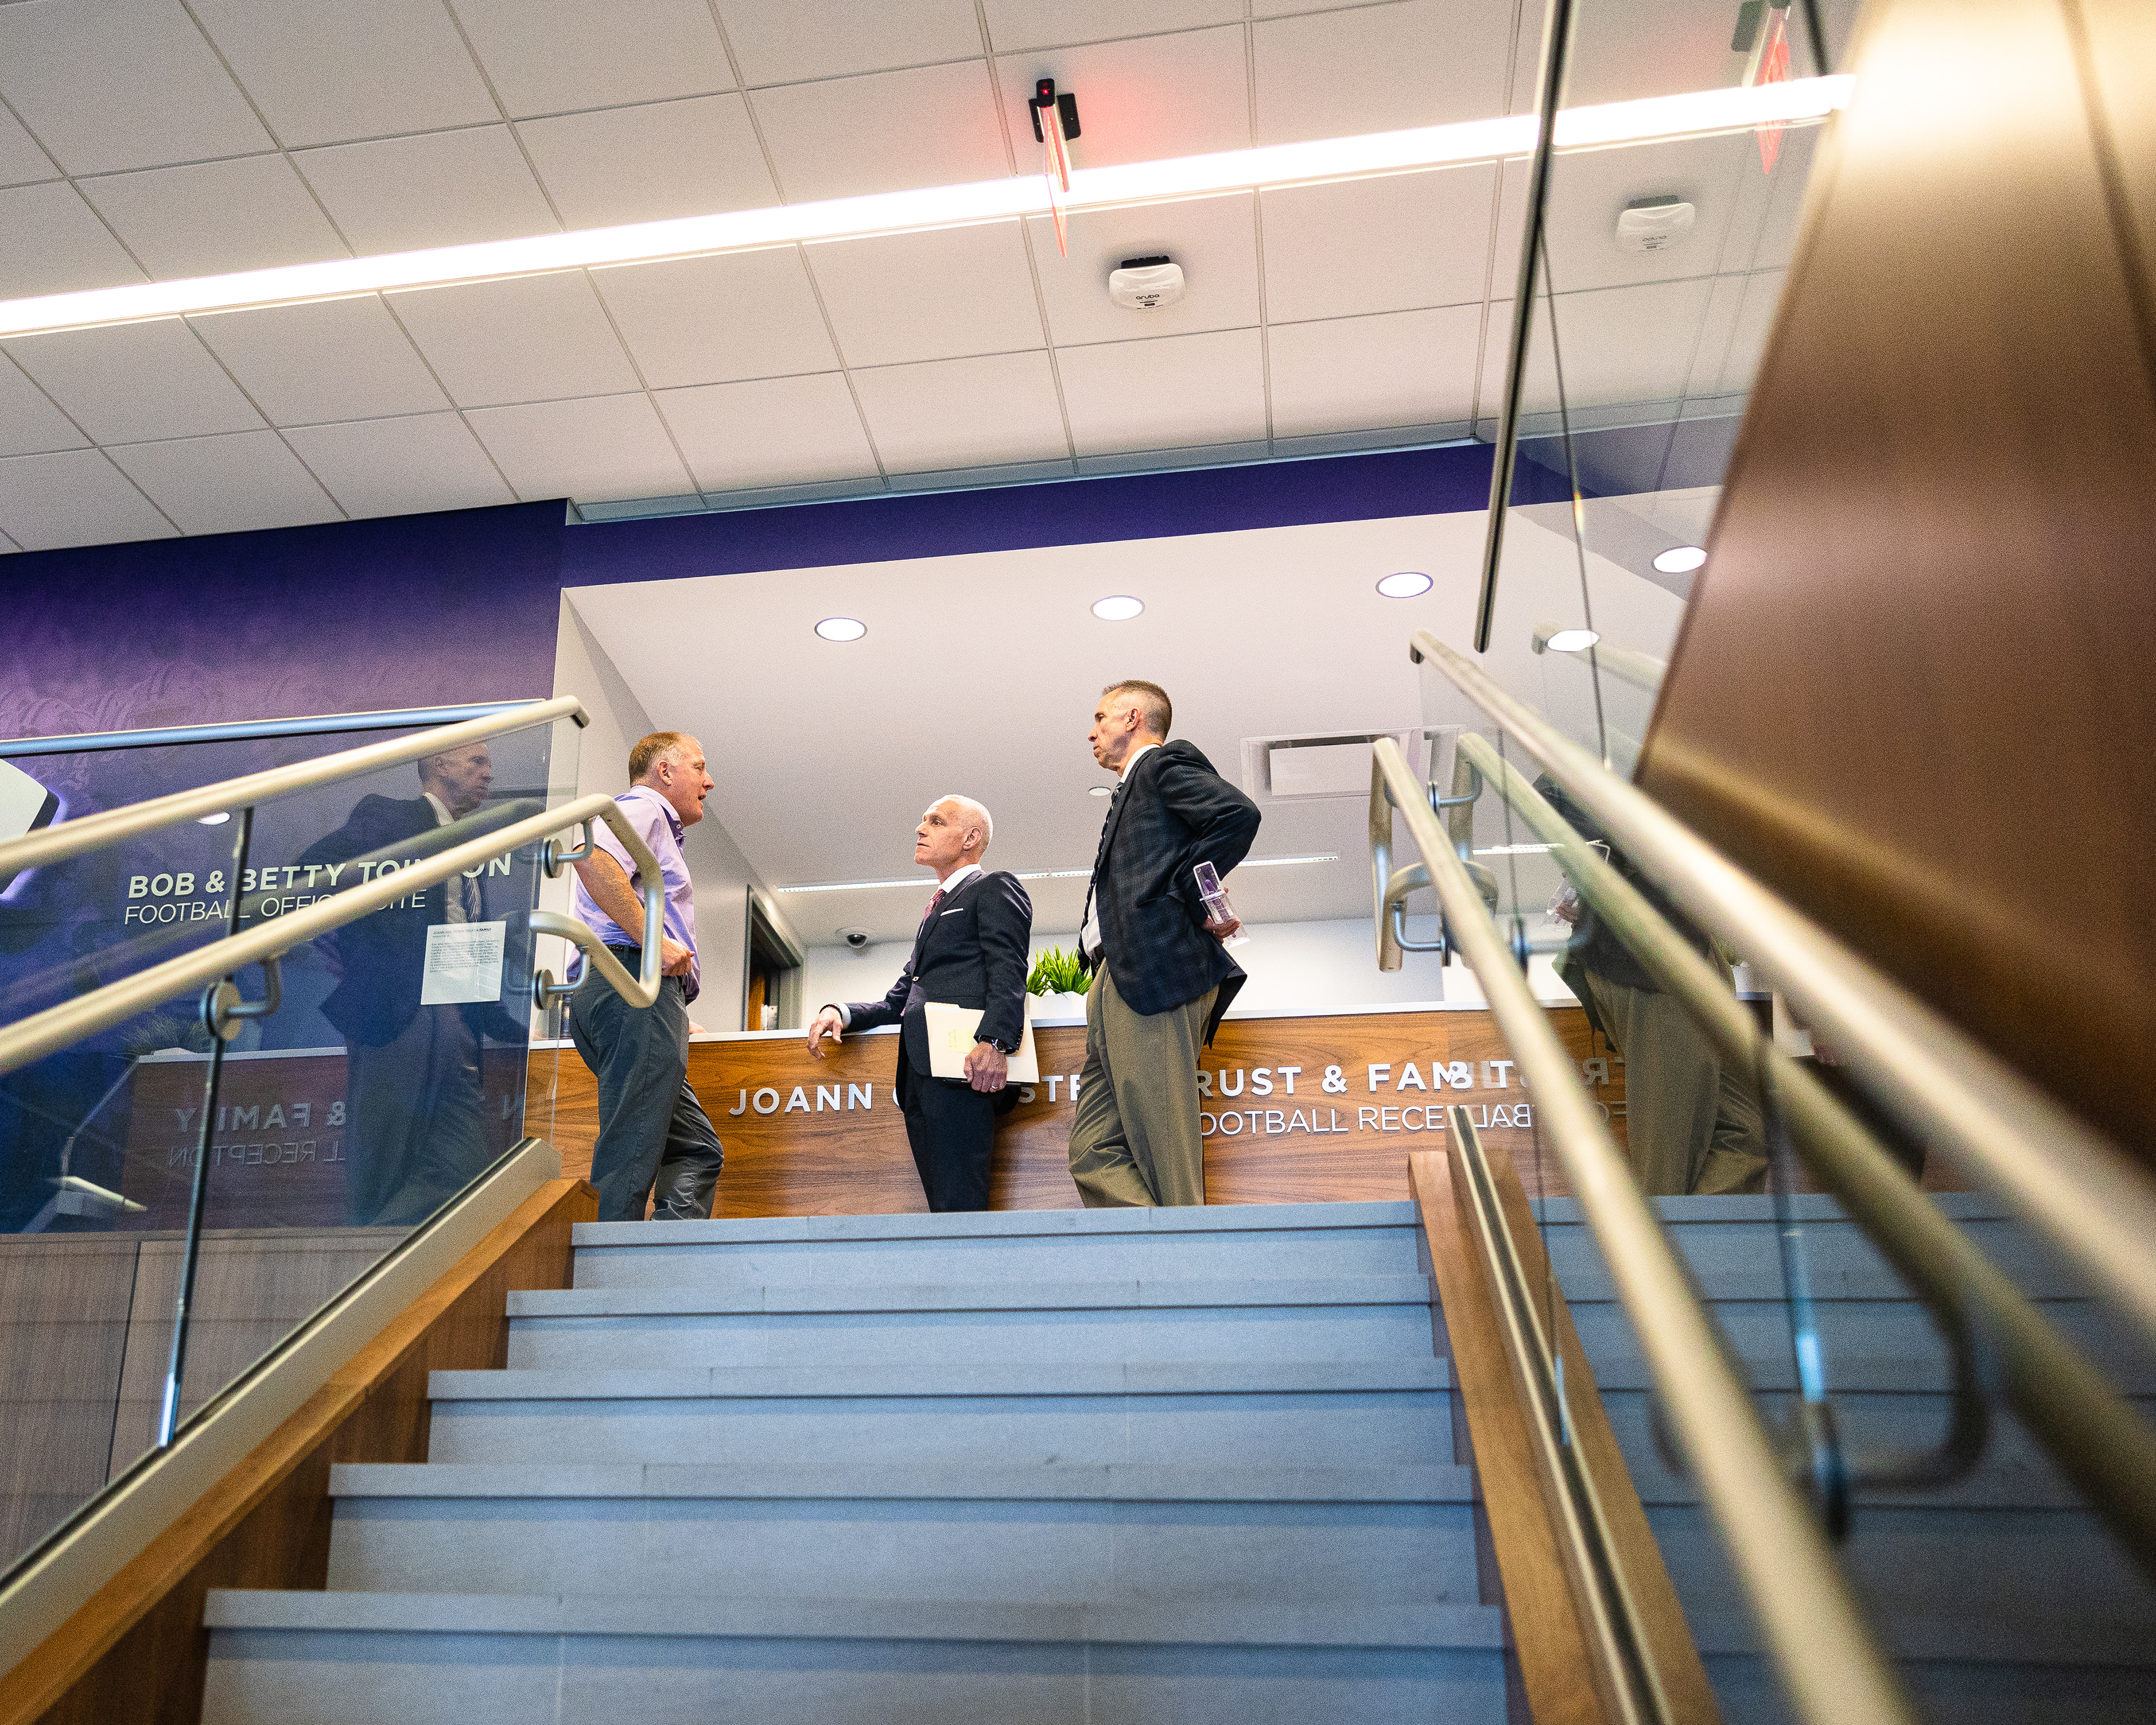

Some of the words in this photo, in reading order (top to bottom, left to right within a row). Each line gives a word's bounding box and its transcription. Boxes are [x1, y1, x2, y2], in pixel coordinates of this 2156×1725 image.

[129, 872, 195, 898] BOB
[205, 870, 225, 893] &
[243, 863, 346, 892] BETTY
[1197, 1066, 1302, 1096] RUST
[1321, 1065, 1347, 1093] &
[729, 1083, 872, 1115] JOANN
[1200, 1108, 1349, 1135] OOTBALL
